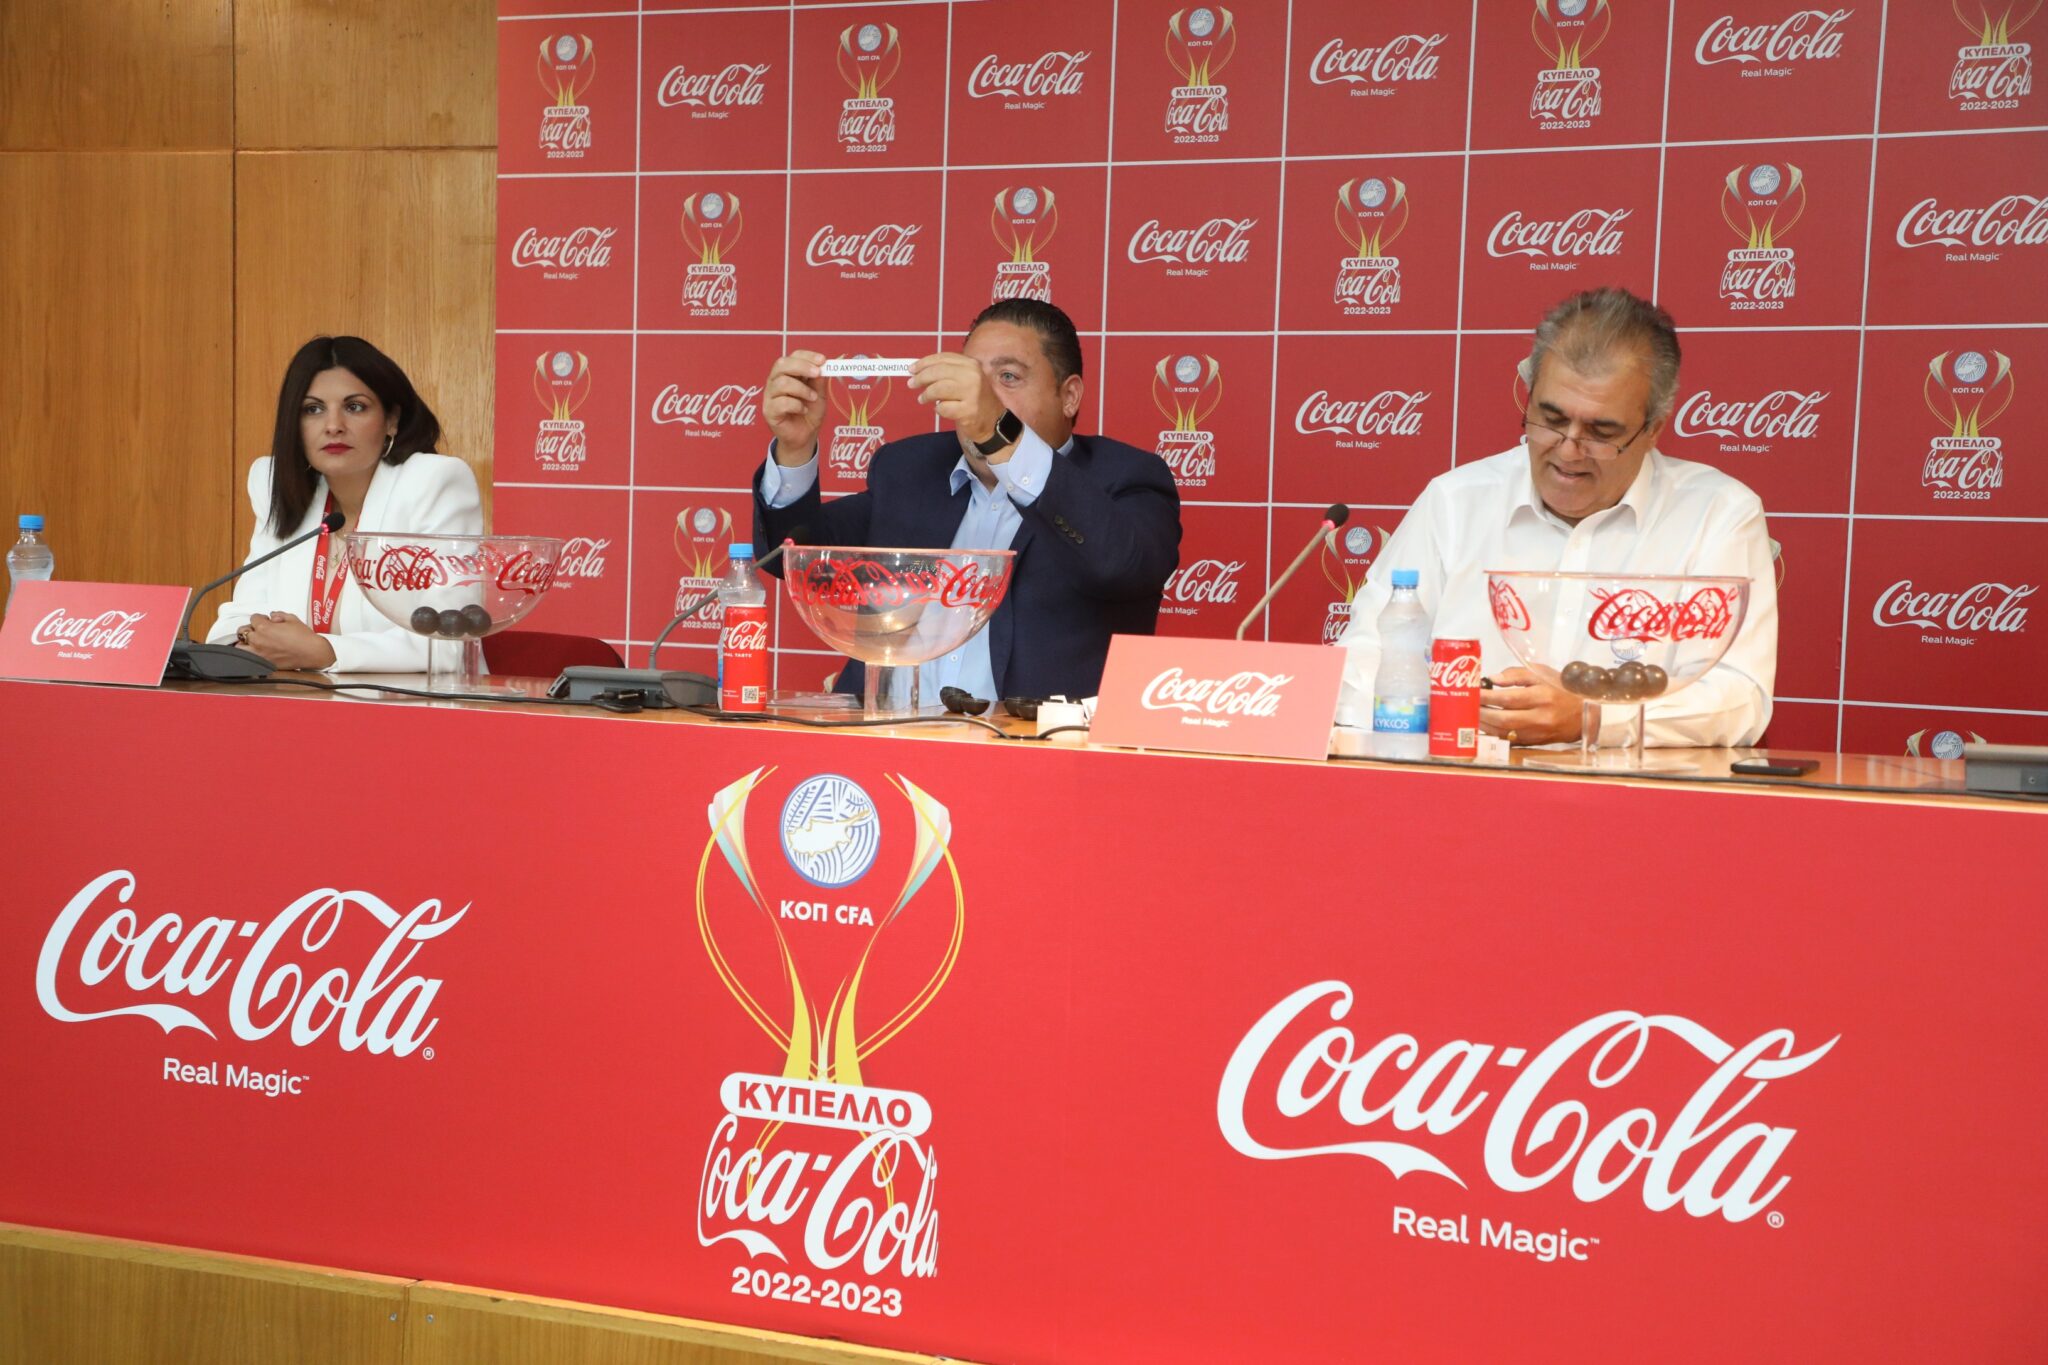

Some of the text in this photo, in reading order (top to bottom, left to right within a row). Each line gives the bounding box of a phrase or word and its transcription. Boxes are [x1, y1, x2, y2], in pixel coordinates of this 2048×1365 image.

[1694, 8, 1855, 65] Coca-Cola
[968, 50, 1092, 98] Coca-Cola
[1309, 34, 1448, 84] Coca-Cola
[657, 63, 772, 107] Coca-Cola
[1350, 89, 1369, 97] Real
[1959, 100, 2019, 111] 2022-2023
[1174, 135, 1219, 143] 2022-2023
[1540, 120, 1591, 130] 2022-2023
[547, 151, 584, 159] 2022-2023
[846, 144, 887, 152] 2022-2023
[511, 227, 618, 268] Coca-Cola
[805, 224, 922, 267] Coca-Cola
[1127, 218, 1259, 264] Coca-Cola
[1486, 208, 1634, 258] Coca-Cola
[1945, 253, 1967, 261] Real
[690, 308, 729, 316] 2022-2023
[1344, 306, 1391, 315] 2022-2023
[1730, 301, 1784, 310] 2022-2023
[651, 384, 762, 425] Coca-Cola
[1295, 390, 1432, 435] Coca-Cola
[1673, 390, 1830, 438] Coca-Cola
[685, 429, 700, 437] Real
[1335, 440, 1354, 448] Real
[1719, 444, 1740, 452] Real
[837, 471, 868, 479] 2022-20
[1933, 491, 1991, 500] 2022-2023
[1174, 607, 1198, 616] Magic
[1872, 580, 2040, 633] Coca-Cola
[31, 608, 148, 649] Coca-Cola
[682, 621, 721, 629] 2022-2023
[1921, 635, 1943, 644] Real
[1141, 667, 1295, 717] Coca-Cola
[835, 903, 874, 926] CFA
[36, 869, 472, 1057] Coca-Cola
[162, 1057, 302, 1097] Real Magic
[1217, 980, 1842, 1223] Coca-Cola
[1392, 1205, 1589, 1262] Real Magic
[731, 1266, 902, 1318] 2022-2023
